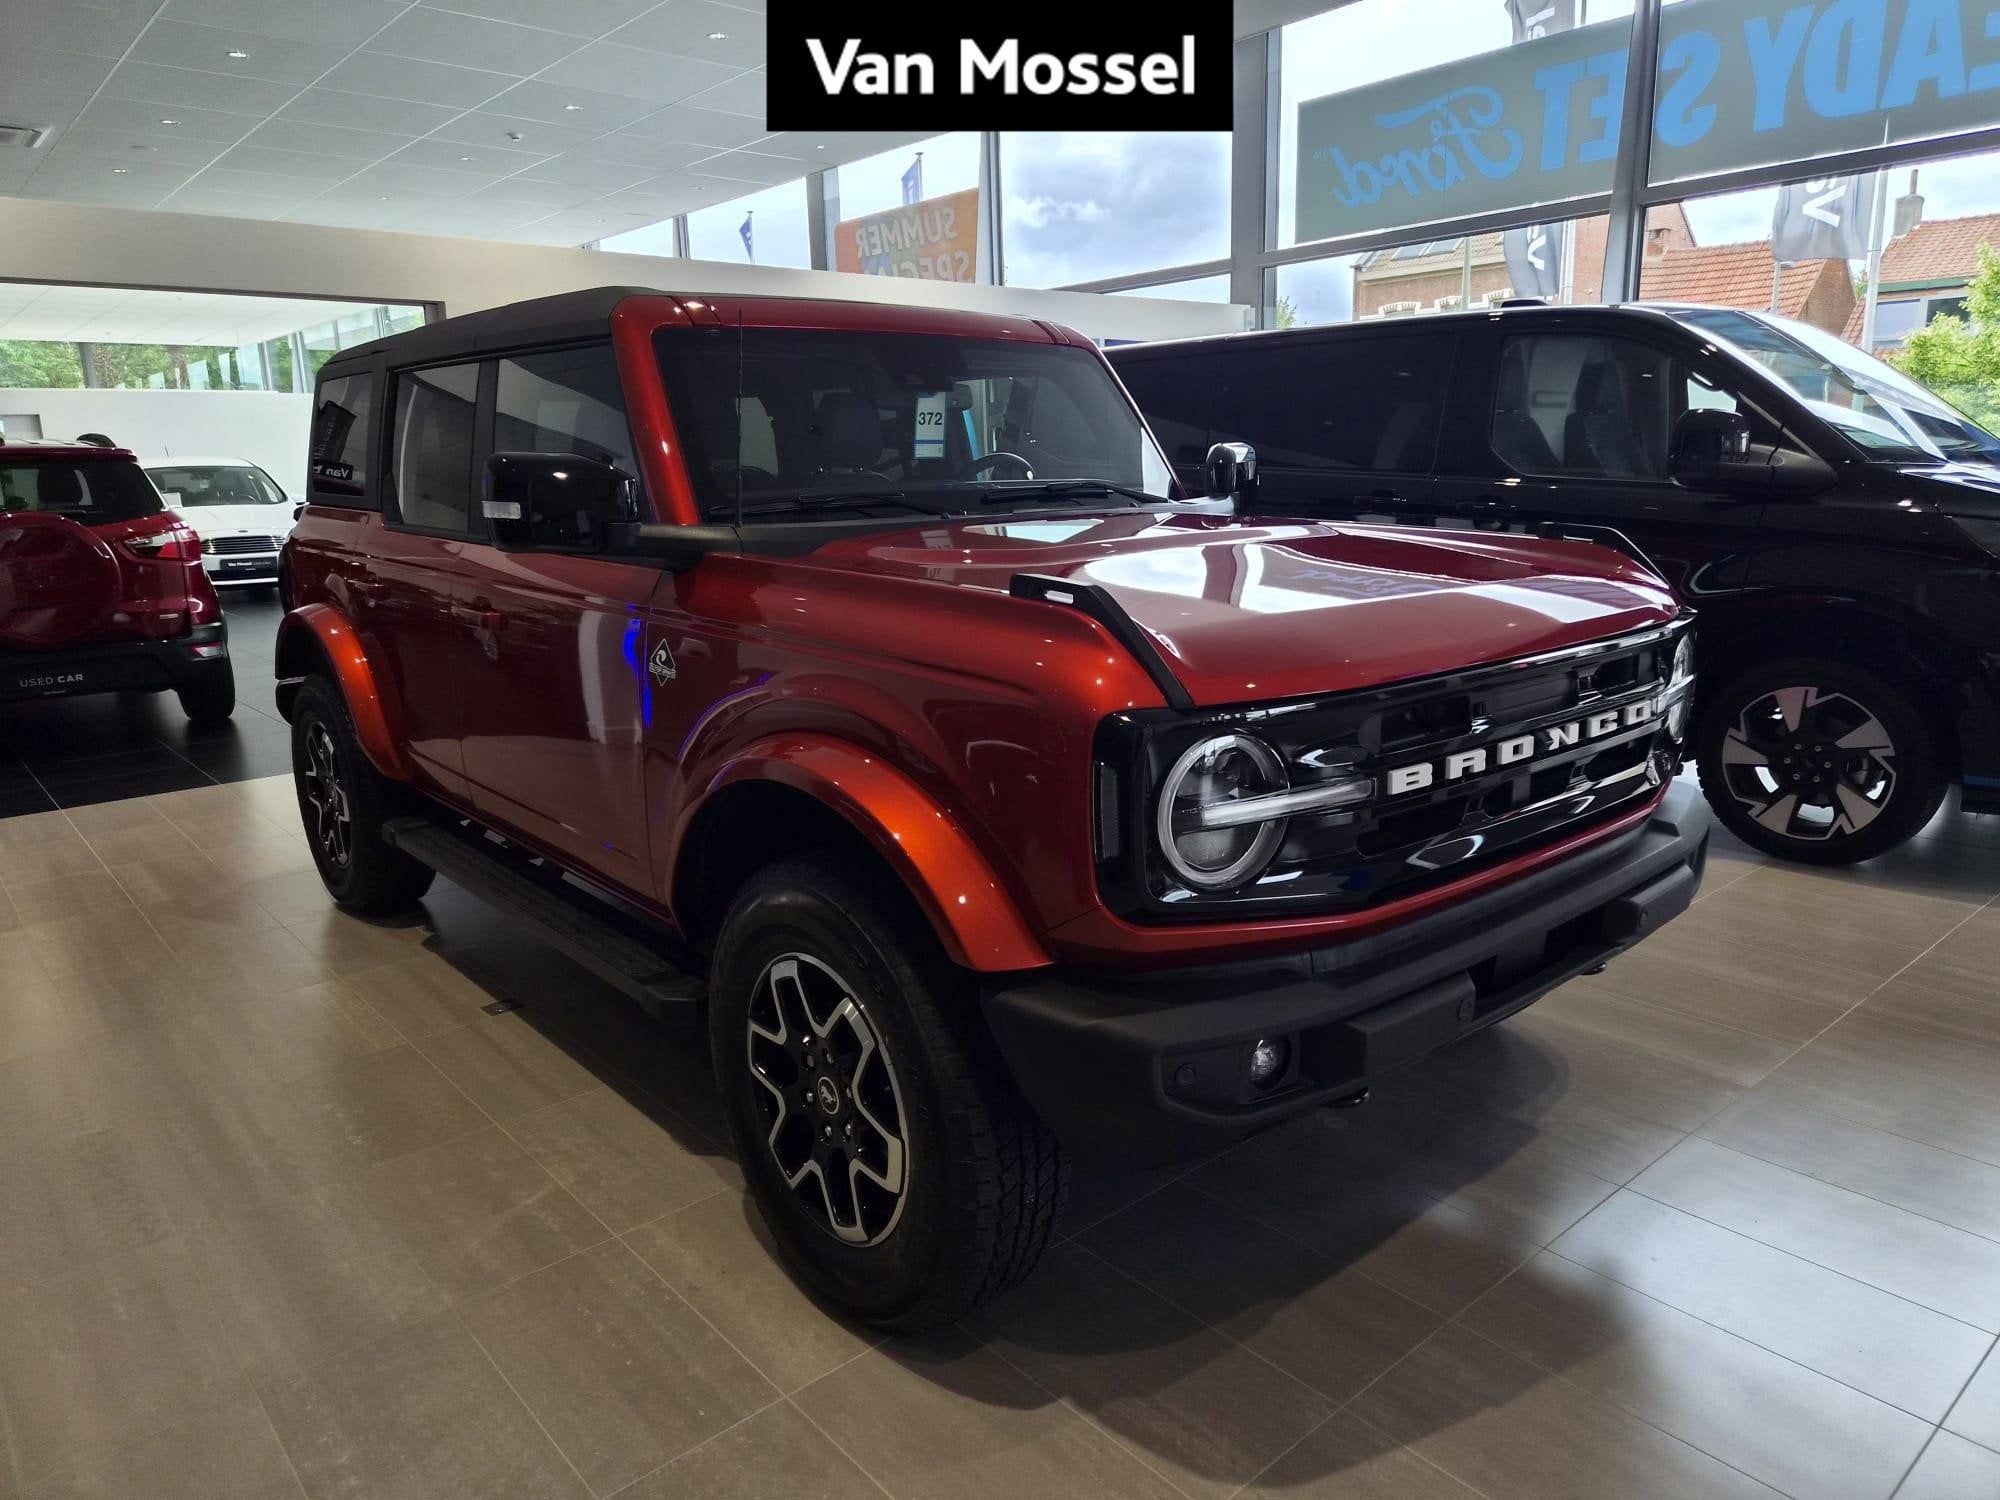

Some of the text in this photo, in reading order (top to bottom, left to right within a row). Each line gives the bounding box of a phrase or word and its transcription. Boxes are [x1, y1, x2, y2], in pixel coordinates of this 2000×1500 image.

[918, 412, 943, 425] 372
[20, 673, 83, 687] USED CAR
[1387, 699, 1652, 796] BRONCO
